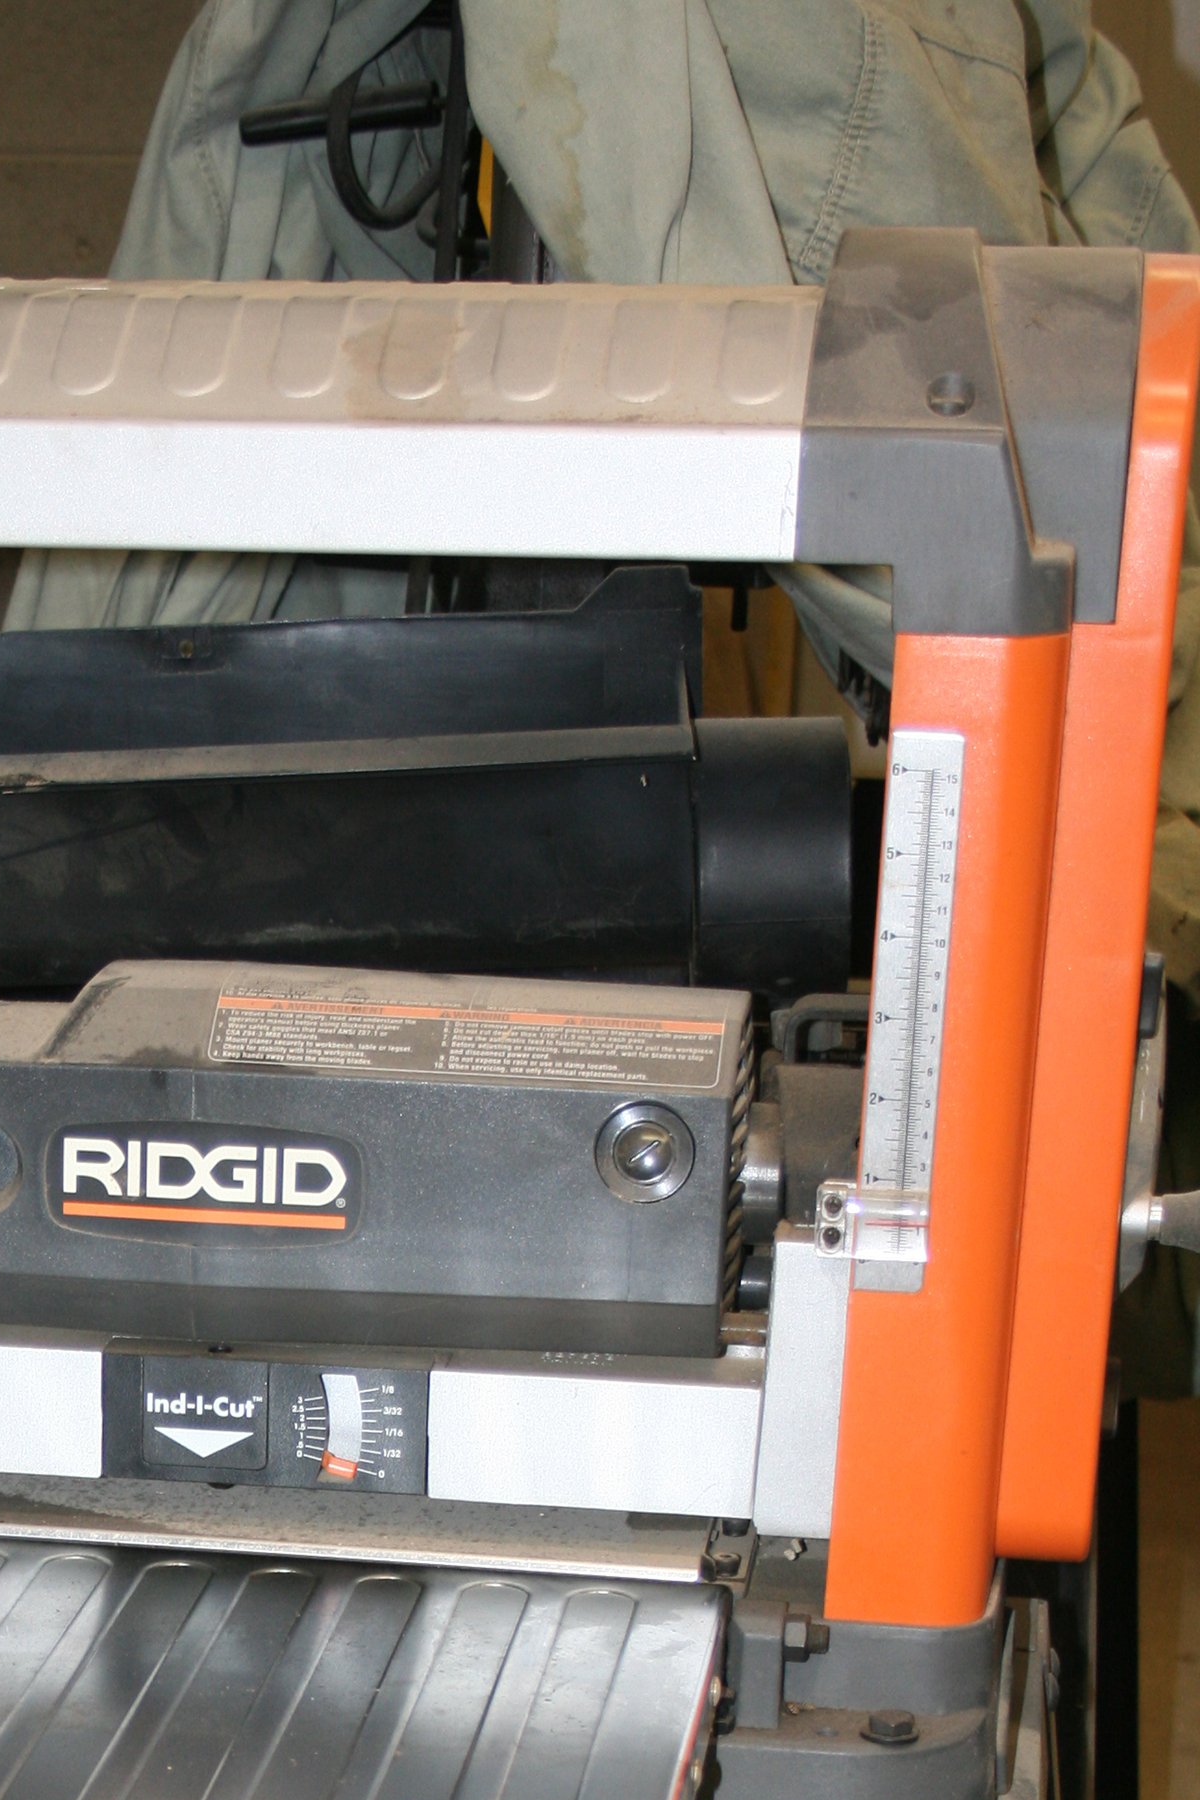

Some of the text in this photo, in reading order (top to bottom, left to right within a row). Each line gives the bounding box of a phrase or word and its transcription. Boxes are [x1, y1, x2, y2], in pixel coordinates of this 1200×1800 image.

[892, 763, 900, 776] 6
[946, 774, 958, 784] 15
[944, 808, 955, 818] 14
[942, 841, 953, 850] 13
[887, 847, 894, 860] 5
[939, 874, 950, 883] 12
[937, 906, 948, 916] 11
[881, 930, 888, 942] 4
[934, 939, 946, 949] 10
[934, 971, 941, 981] 9
[931, 1003, 938, 1013] 8
[874, 1012, 882, 1024] 3
[930, 1035, 936, 1045] 7
[927, 1067, 933, 1077] 6
[869, 1092, 877, 1105] 2
[925, 1099, 931, 1109] 5
[922, 1131, 929, 1141] 4
[63, 1137, 347, 1207] RIDGID
[920, 1162, 926, 1172] 3
[865, 1173, 871, 1185] 1
[381, 1385, 395, 1394] 1/8
[146, 1392, 255, 1418] Ind-I-Cut
[297, 1396, 303, 1404] 3
[383, 1407, 402, 1416] 3/32
[299, 1414, 305, 1422] 2
[294, 1423, 306, 1431] 1.5
[385, 1428, 404, 1437] 1/16
[296, 1441, 304, 1449] .5
[296, 1450, 303, 1458] 0
[383, 1449, 401, 1458] 1/32
[378, 1470, 385, 1478] 0
